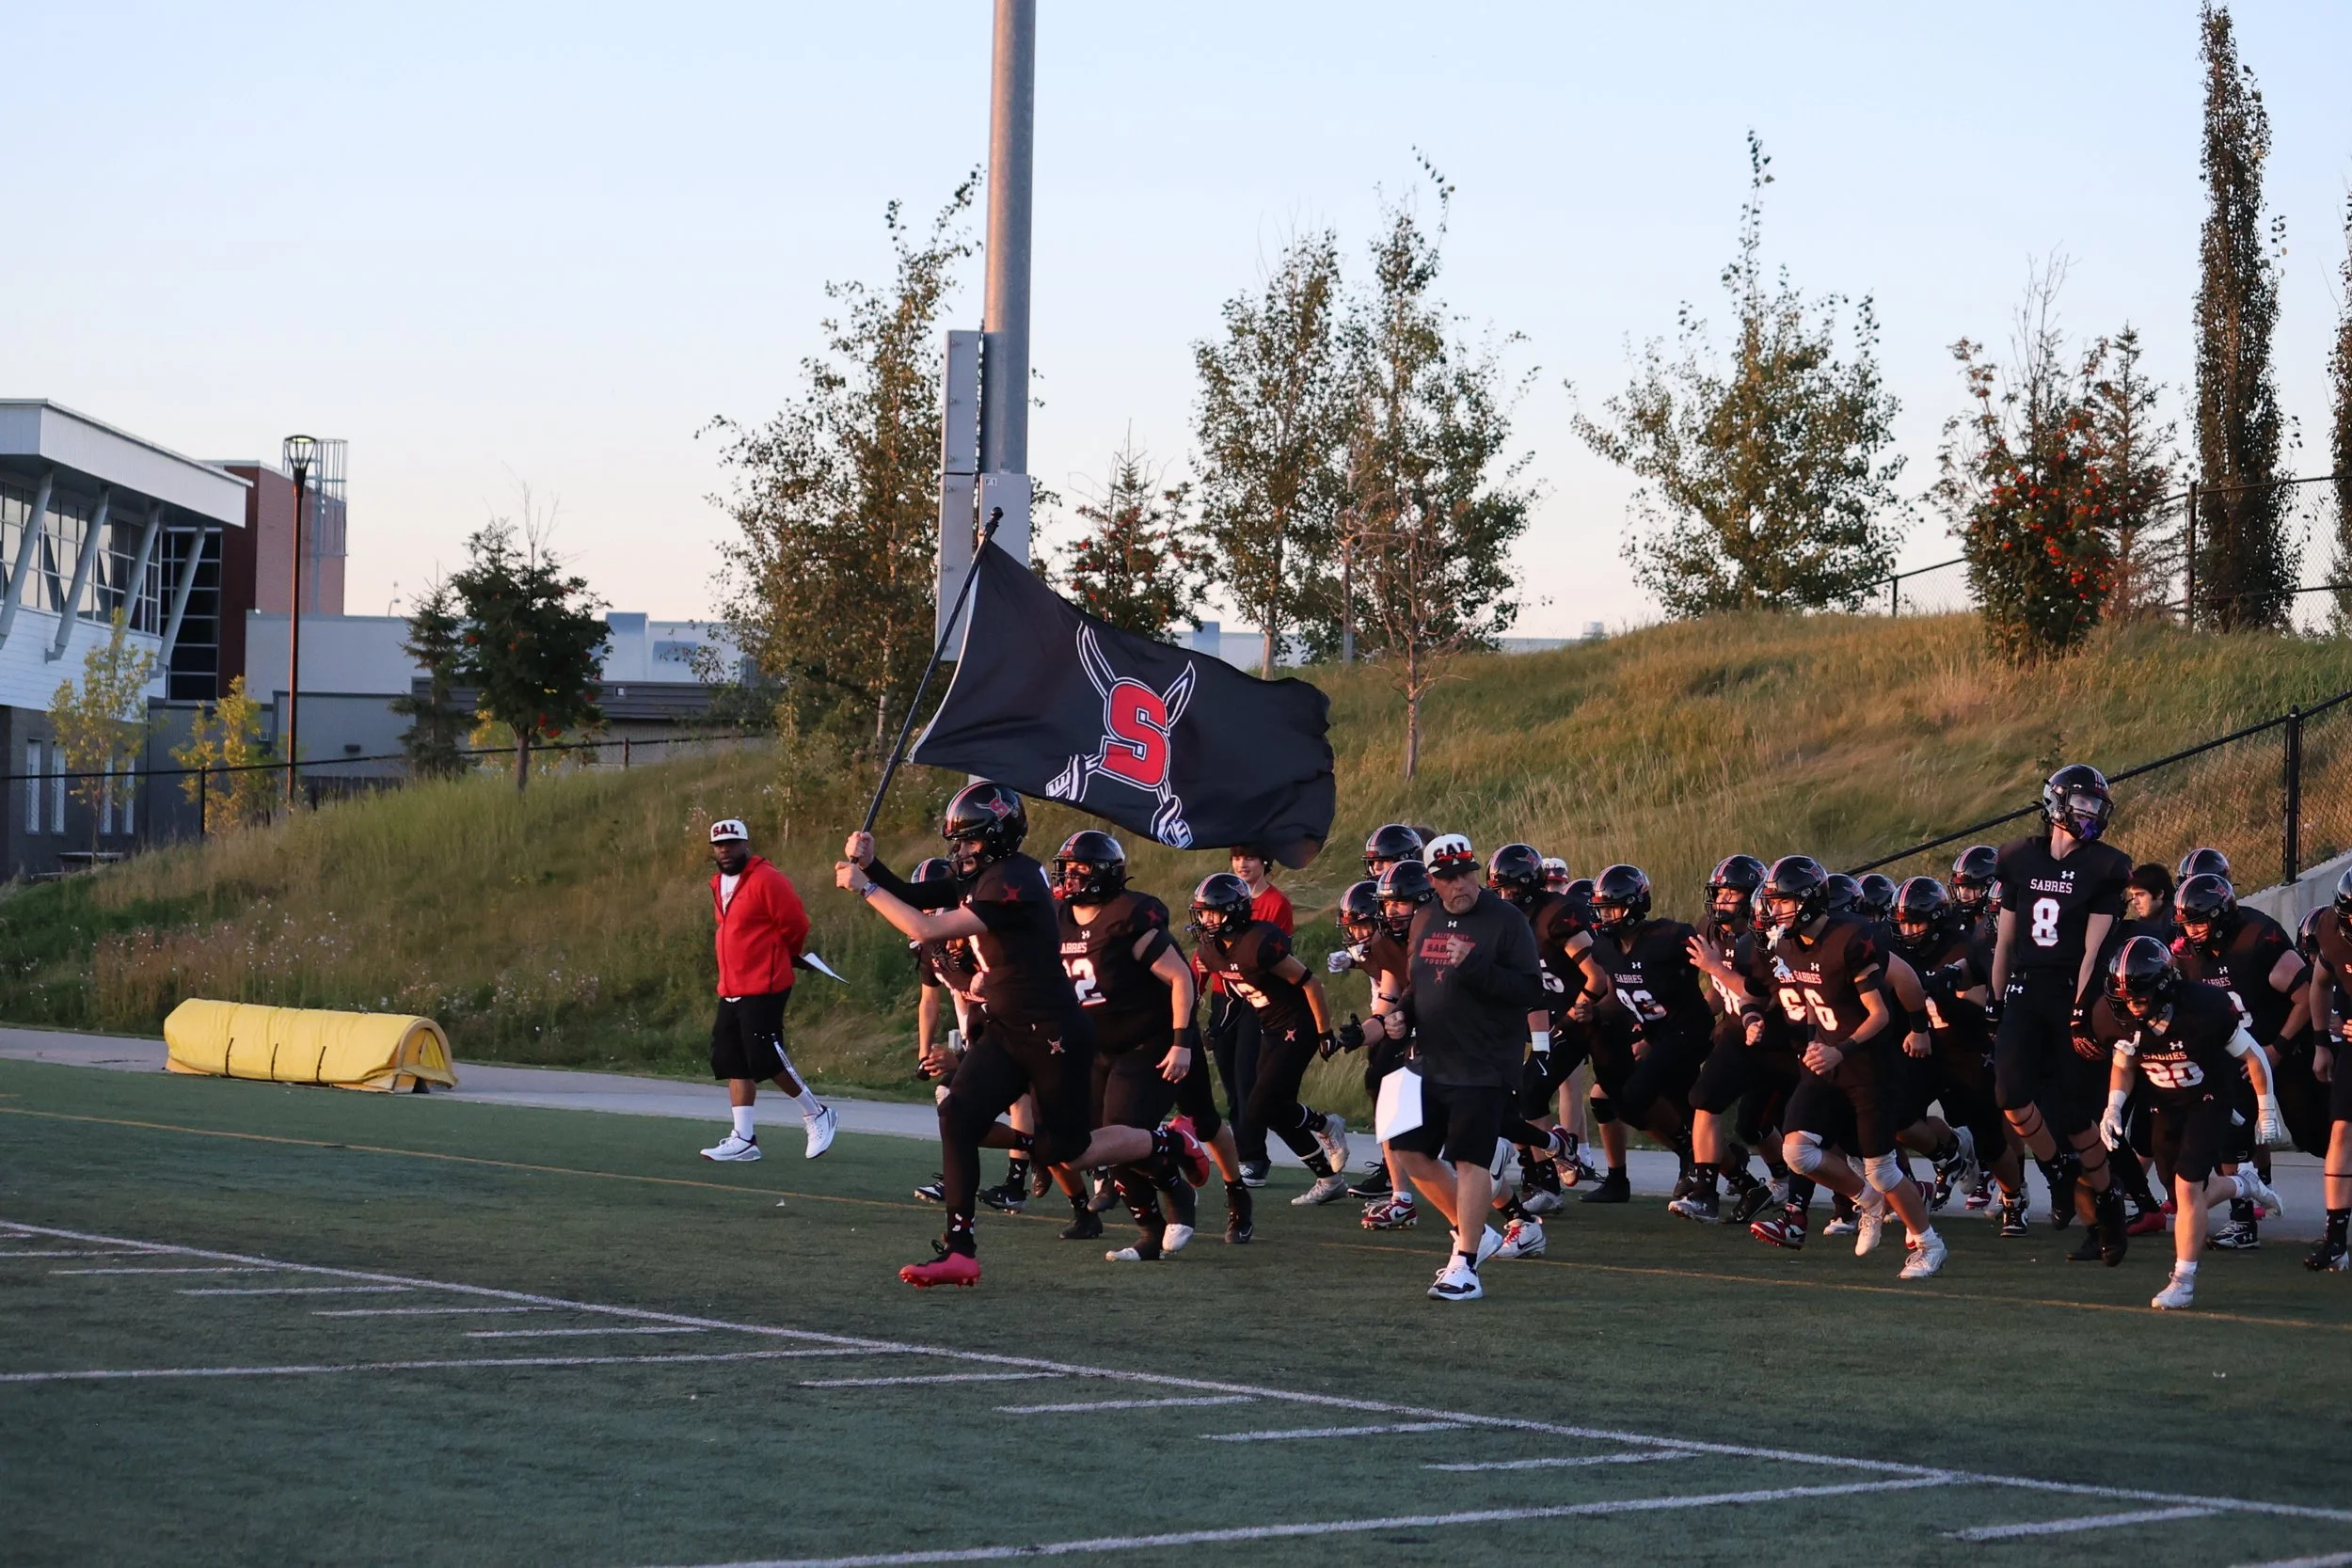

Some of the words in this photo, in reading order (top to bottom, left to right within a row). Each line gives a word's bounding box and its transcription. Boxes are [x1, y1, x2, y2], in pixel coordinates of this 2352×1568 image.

[1099, 676, 1171, 791] S
[712, 822, 739, 837] SAL
[2029, 878, 2074, 895] SABRES
[2031, 896, 2060, 947] 8
[1059, 942, 1088, 955] ABRES
[1425, 943, 1447, 954] SAB
[1614, 973, 1644, 984] SABRES
[1794, 970, 1822, 985] SABRES
